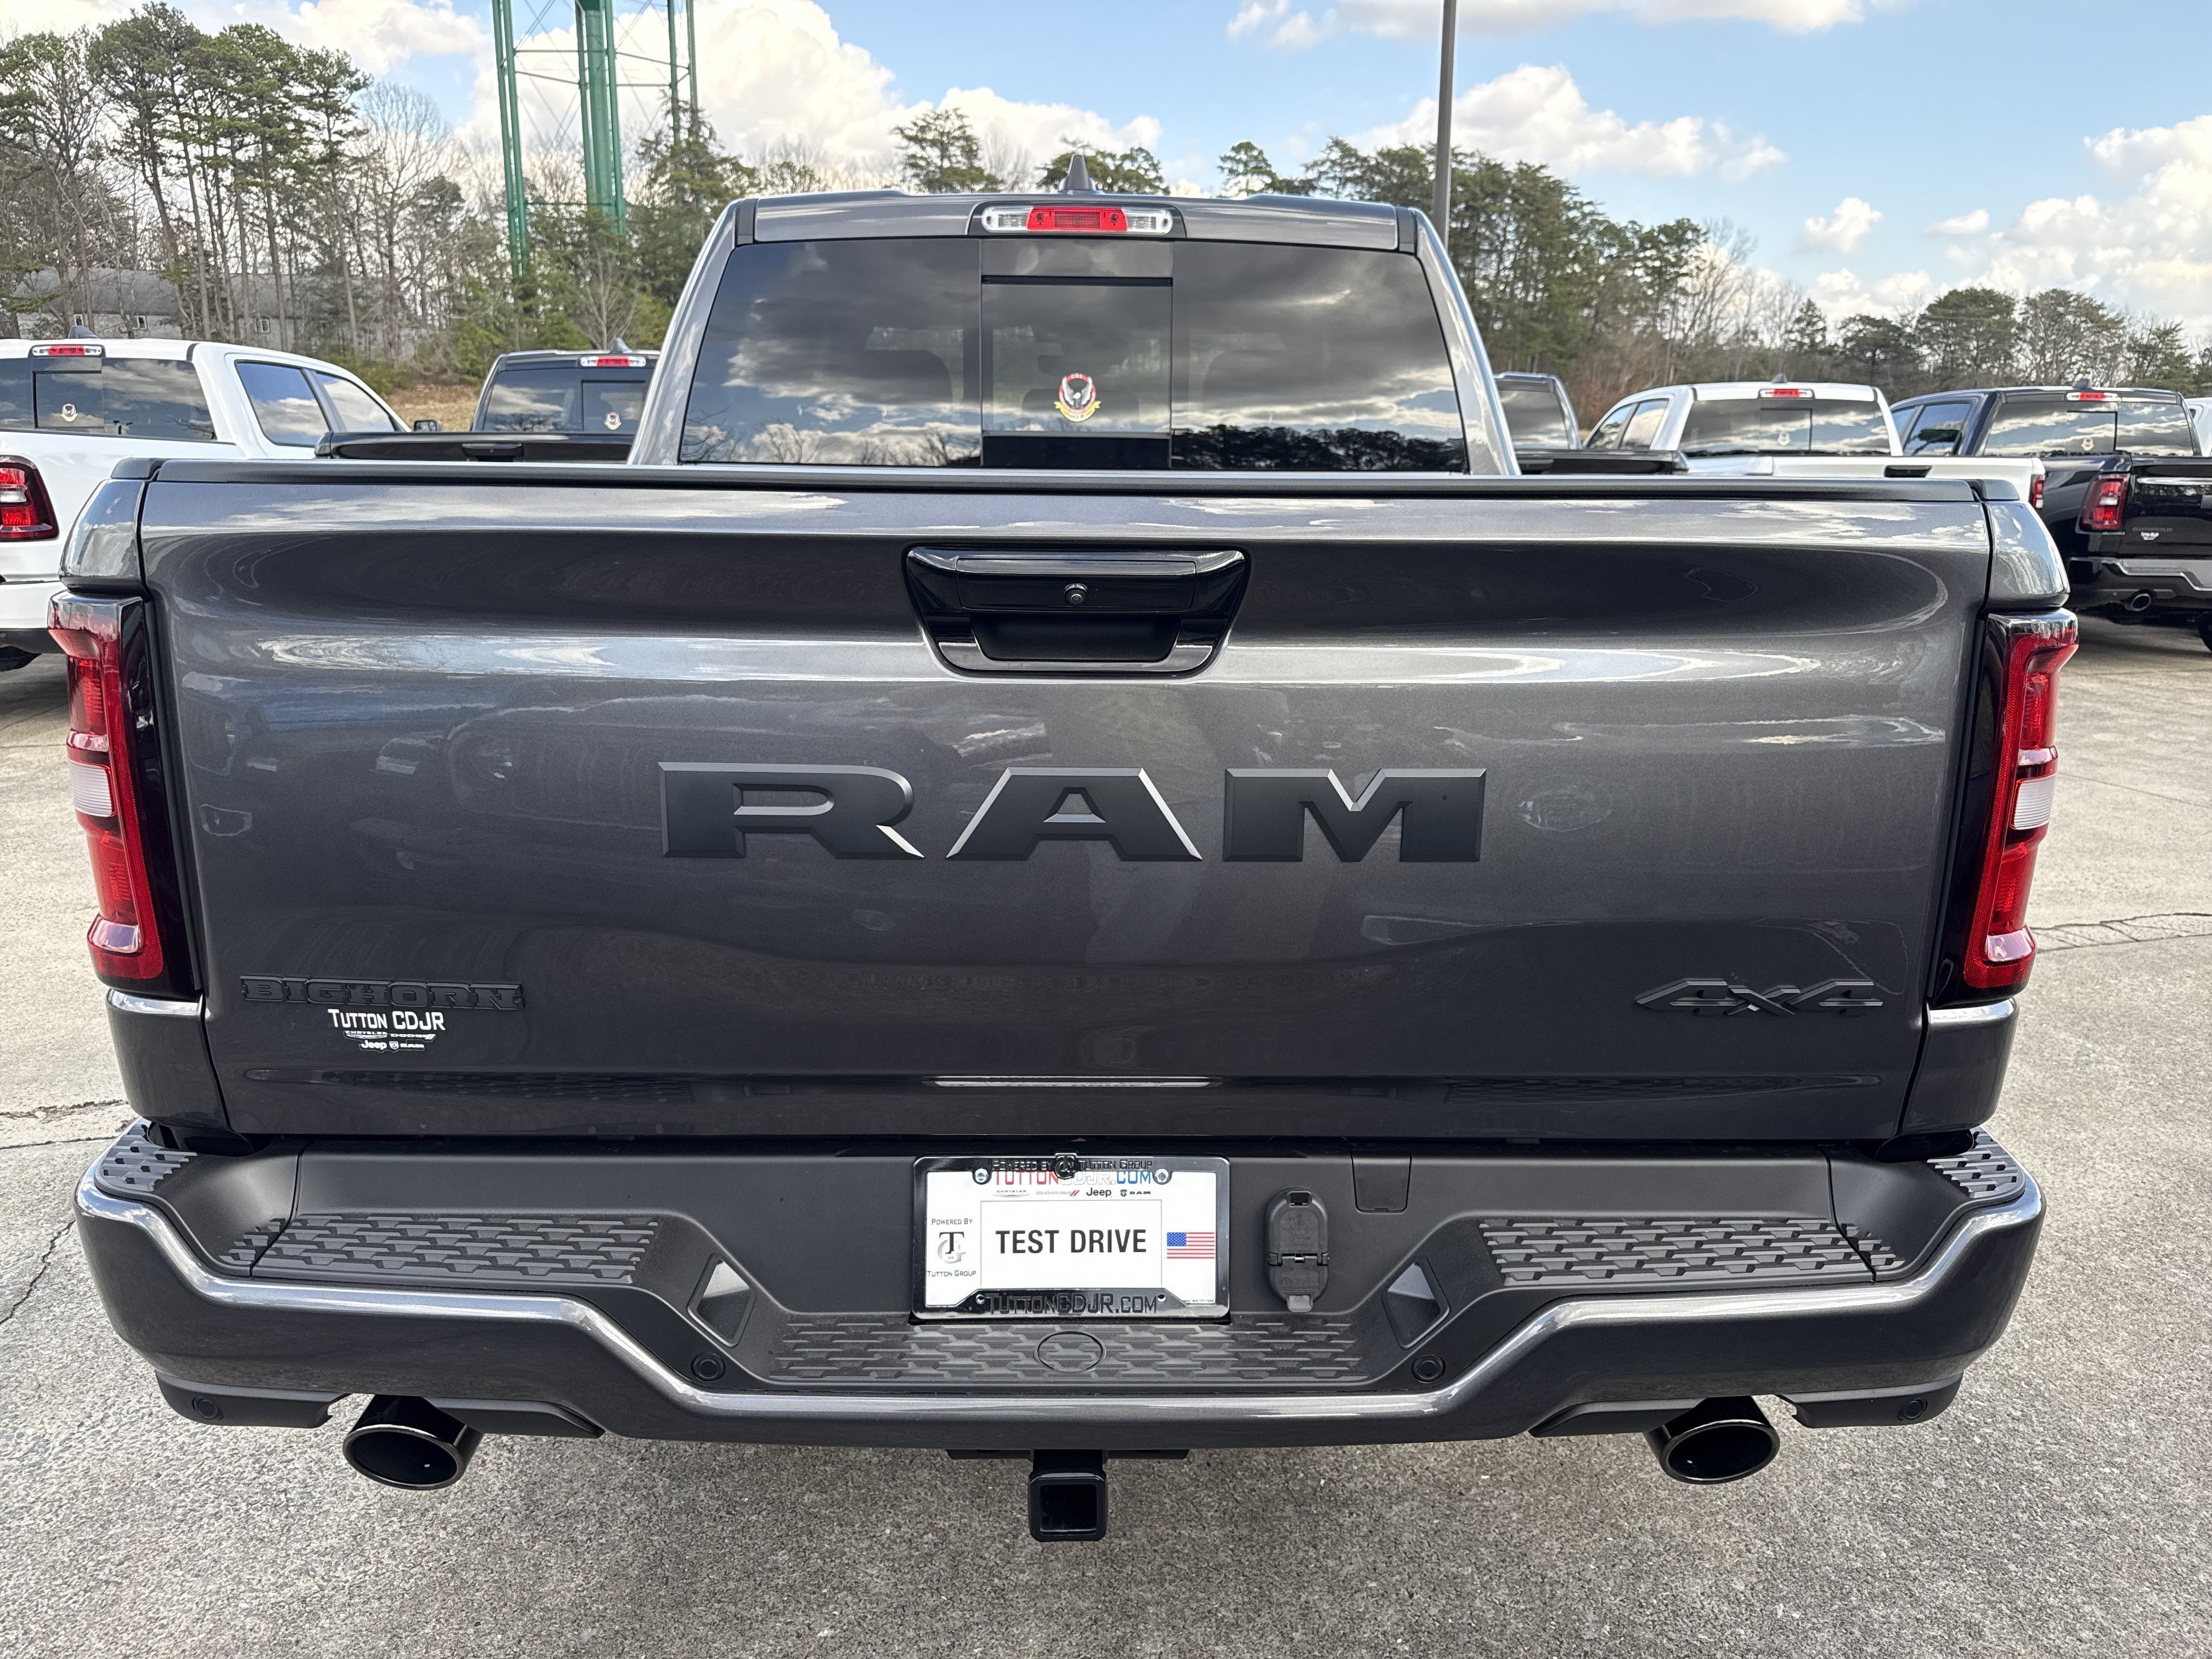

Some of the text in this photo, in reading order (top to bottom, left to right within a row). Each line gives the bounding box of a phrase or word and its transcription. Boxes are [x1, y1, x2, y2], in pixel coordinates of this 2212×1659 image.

[658, 761, 1487, 862] RAM
[240, 975, 525, 1011] BIGHORN
[392, 1011, 446, 1030] CDJR
[361, 1040, 387, 1050] Jeep
[1086, 1187, 1111, 1198] Jeep
[996, 1229, 1147, 1254] TEST DRIVE
